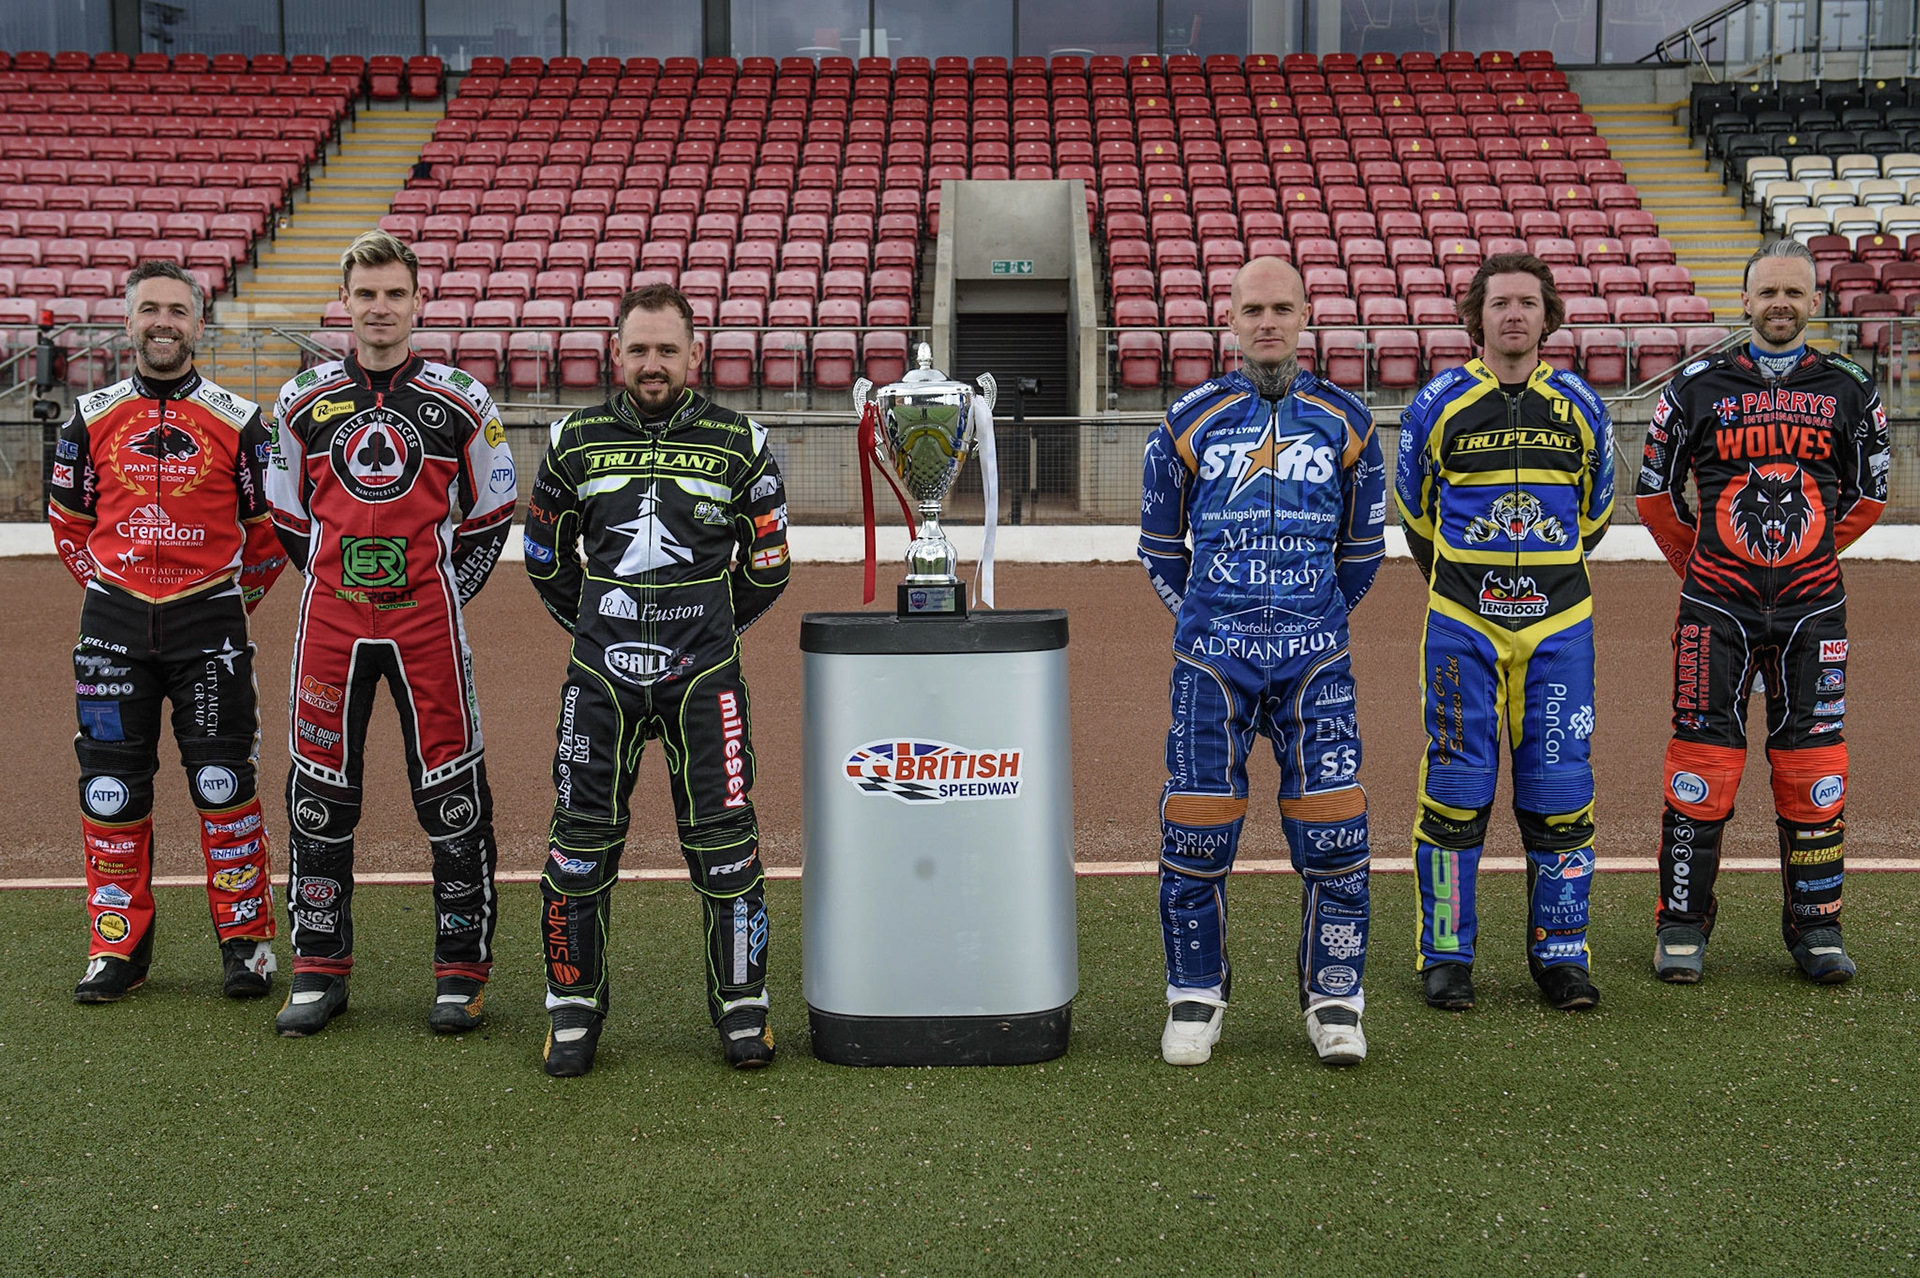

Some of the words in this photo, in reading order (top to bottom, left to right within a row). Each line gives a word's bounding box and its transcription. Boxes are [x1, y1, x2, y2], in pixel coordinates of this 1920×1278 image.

[83, 387, 126, 413] Crendon
[202, 389, 246, 418] Crendon
[1741, 388, 1837, 418] PARRYS
[316, 404, 353, 418] Rentruck
[425, 406, 440, 422] 4
[585, 416, 615, 424] PLANT
[1554, 399, 1570, 422] 4
[1743, 411, 1833, 429] INTERNATIONAL
[335, 416, 366, 446] BELLE
[396, 421, 418, 448] ACES
[698, 420, 716, 428] TRU
[716, 423, 746, 433] PLANT
[1206, 428, 1234, 438] KING'S
[1236, 425, 1262, 435] LYNN
[1457, 433, 1499, 451] TRU
[1501, 431, 1576, 448] PLANT
[1716, 423, 1832, 461] WOLVES
[124, 464, 196, 475] PANTHERS
[591, 452, 636, 468] TRU
[638, 452, 720, 471] PLANT
[490, 468, 513, 481] ATPI
[355, 485, 401, 497] MANCHESTER
[116, 521, 205, 540] Crendon
[1221, 528, 1316, 552] Minors
[134, 567, 157, 575] CITY
[158, 568, 204, 576] AUCTION
[149, 577, 183, 585] GROUP
[1207, 552, 1240, 584] &
[1246, 559, 1325, 592] Brady
[641, 603, 706, 622] Euston
[1212, 621, 1230, 631] The
[1232, 621, 1271, 634] Norfolk
[1274, 622, 1307, 633] Cabin
[83, 637, 128, 654] STELLAR
[1191, 635, 1283, 660] ADRIAN
[1288, 630, 1338, 657] FLUX
[1823, 641, 1847, 655] NGK
[205, 660, 217, 688] CITY
[1445, 654, 1460, 687] Ltd
[1677, 624, 1699, 709] PARRYS
[1699, 625, 1711, 711] INTERNATIONAL
[1433, 665, 1446, 697] Car
[1176, 672, 1192, 715] Brady
[194, 682, 205, 727] GROUP
[298, 718, 317, 734] BLUE
[317, 727, 341, 743] DOOR
[559, 685, 580, 761] WELDING
[1449, 691, 1463, 752] Services
[1545, 683, 1567, 764] PlanCon
[299, 729, 333, 750] PROJECT
[572, 733, 590, 764] Ltd
[720, 692, 747, 807] milesey
[895, 752, 1020, 780] BRITISH
[202, 777, 229, 790] ATPI
[939, 781, 1019, 797] SPEEDWAY
[1677, 780, 1700, 795] ATPI
[1819, 784, 1839, 799] ATPI
[92, 790, 119, 802] ATPI
[298, 805, 323, 825] ATPI
[445, 802, 470, 821] ATPI
[1167, 828, 1229, 847] ADRIAN
[1175, 843, 1216, 860] FLUX
[1167, 887, 1181, 936] NORFOLK
[1551, 915, 1562, 924] &
[1564, 914, 1584, 923] CO.
[548, 893, 568, 961] SIMPL
[1321, 922, 1356, 937] east
[1320, 931, 1363, 948] coast
[1328, 947, 1360, 960] signs
